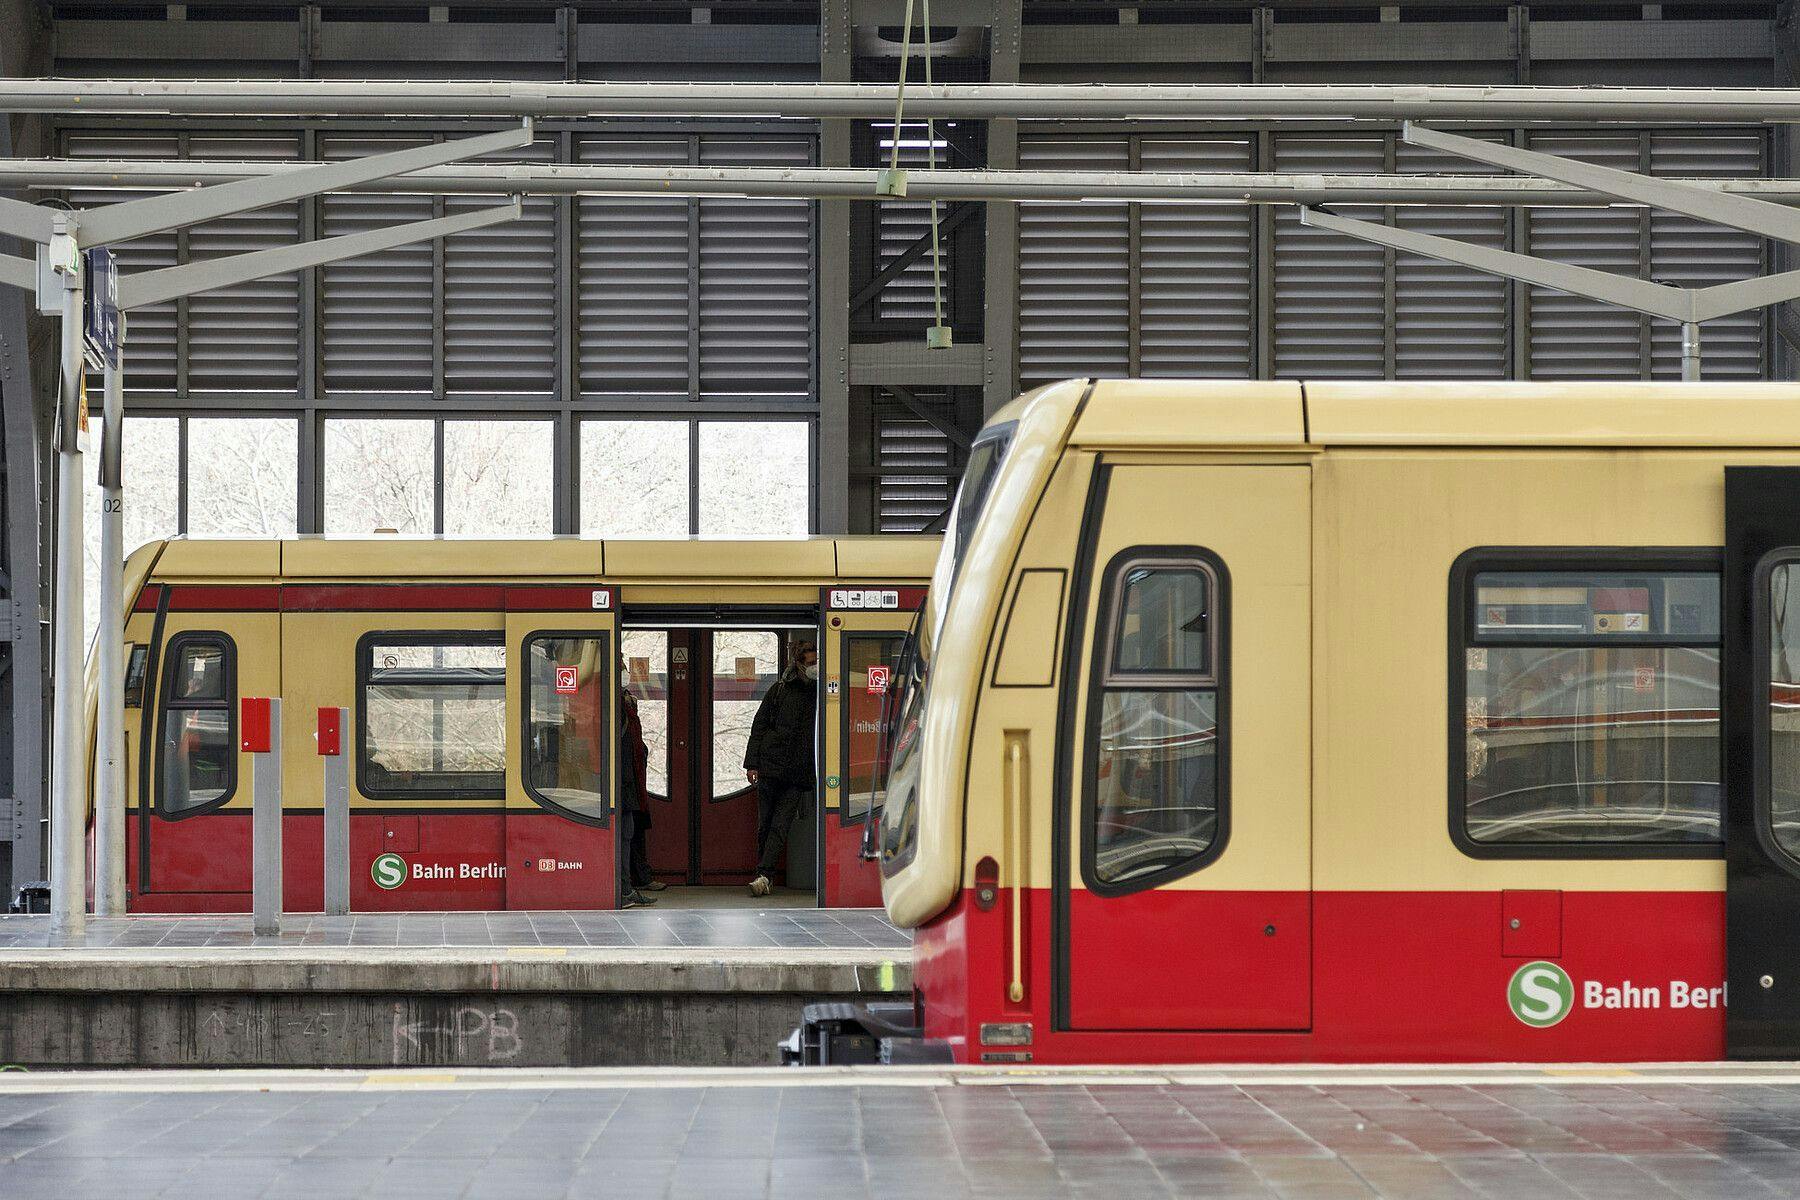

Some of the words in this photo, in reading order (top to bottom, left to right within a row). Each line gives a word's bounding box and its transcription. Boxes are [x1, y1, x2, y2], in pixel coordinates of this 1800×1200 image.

[104, 499, 121, 513] 02
[412, 863, 454, 879] Bahn
[459, 862, 507, 879] Berlin
[540, 860, 555, 871] DB
[557, 861, 583, 870] BAHN
[1583, 980, 1660, 1009] Bahn
